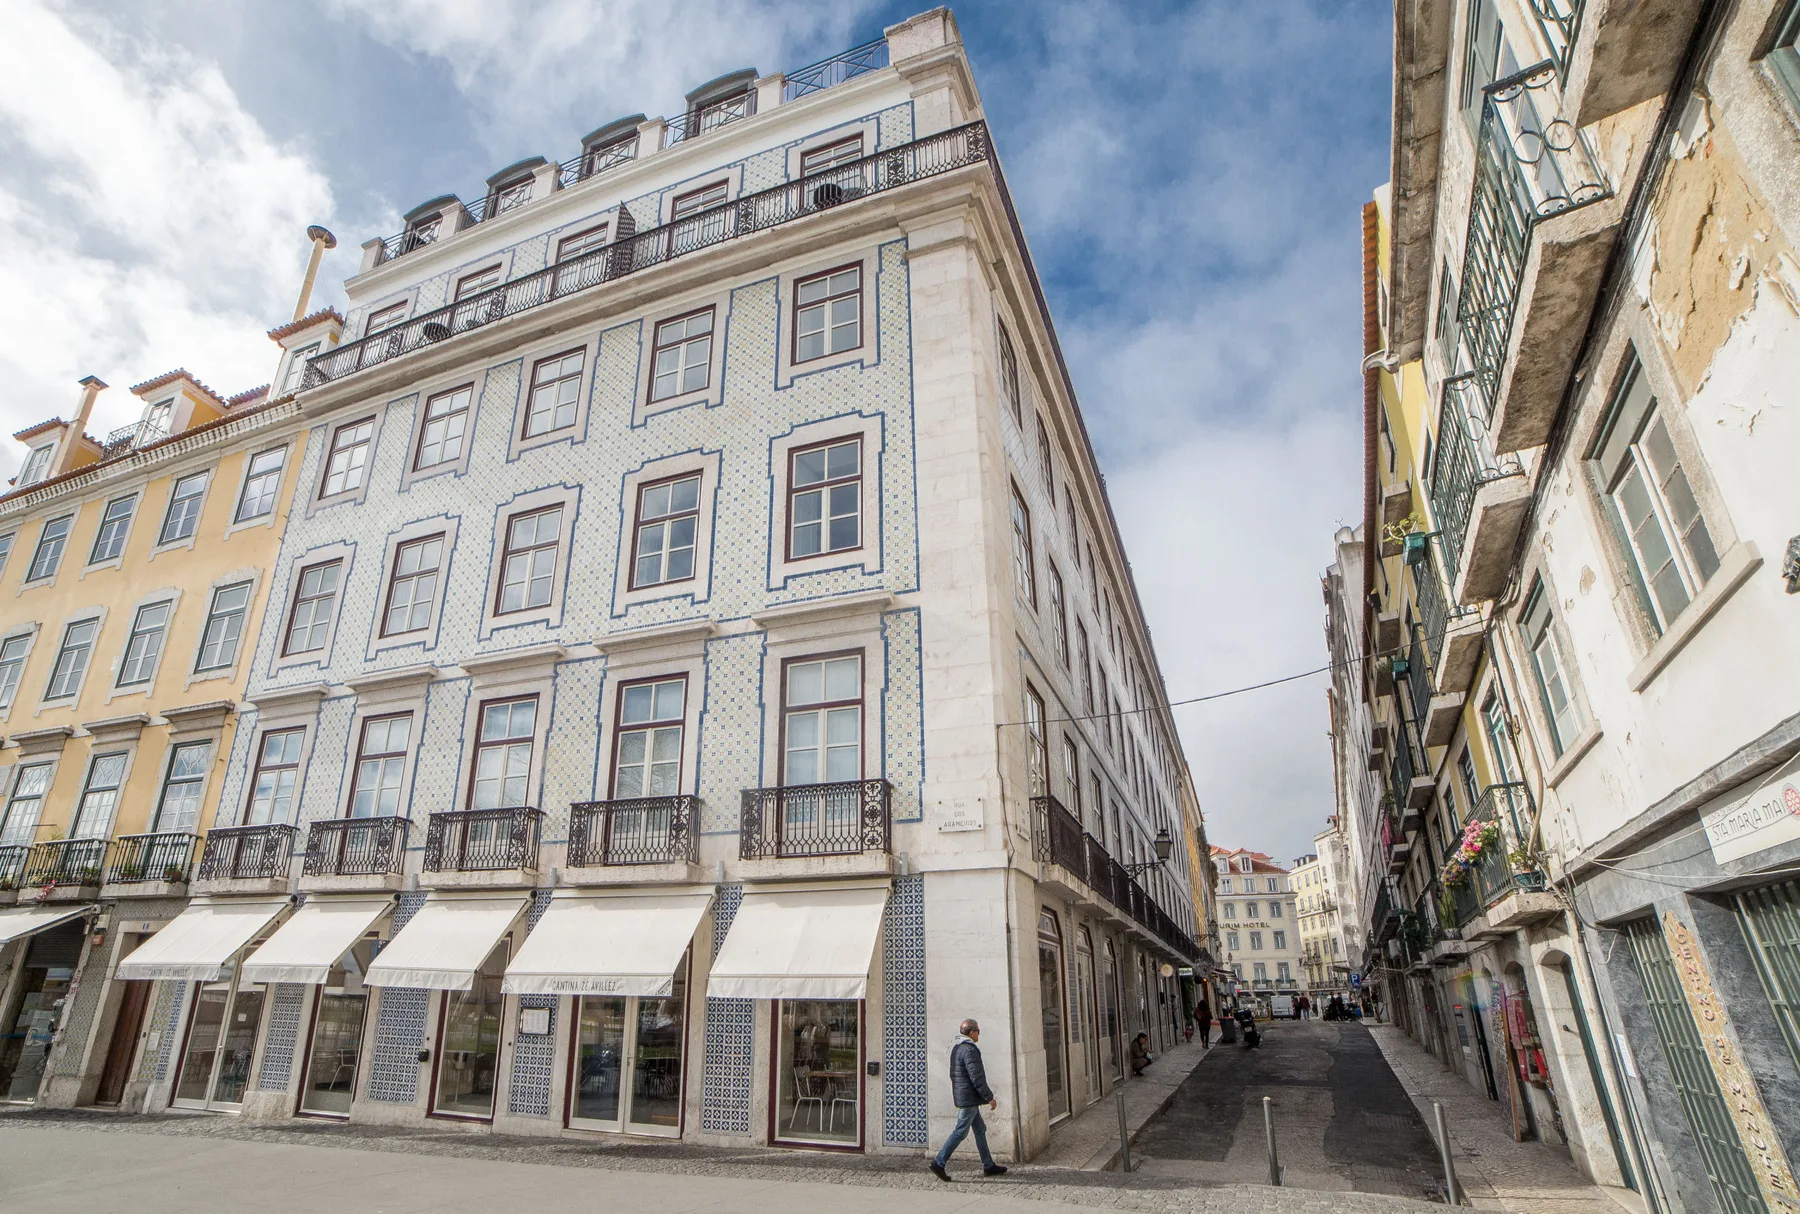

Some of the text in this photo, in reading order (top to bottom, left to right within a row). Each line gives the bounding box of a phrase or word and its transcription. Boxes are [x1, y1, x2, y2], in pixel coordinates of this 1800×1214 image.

[943, 820, 977, 828] ARAMEIROS
[1729, 808, 1762, 830] MARIA
[552, 980, 579, 991] CANTINA
[591, 981, 616, 992] AVILLEZ
[1351, 974, 1358, 984] P
[1675, 933, 1716, 1022] CENTRO
[1731, 1083, 1793, 1214] MANUTEN
